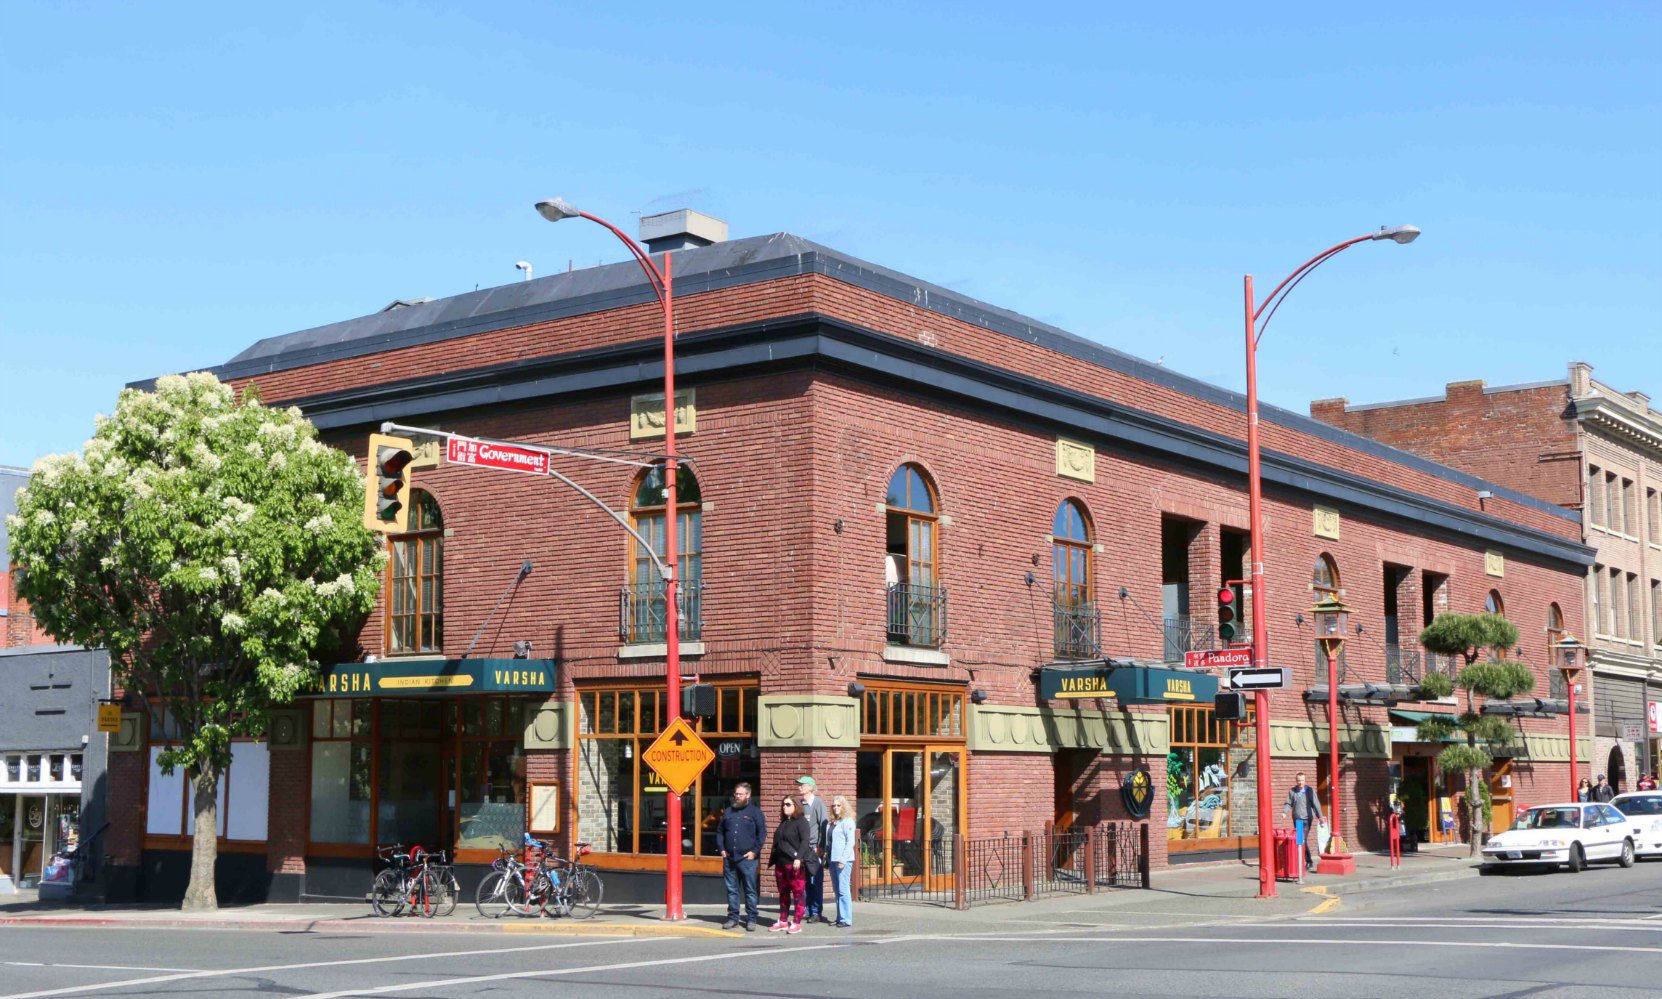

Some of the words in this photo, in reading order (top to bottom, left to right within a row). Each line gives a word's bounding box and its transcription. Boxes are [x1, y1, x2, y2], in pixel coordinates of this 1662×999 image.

[479, 445, 545, 467] Government
[1207, 652, 1250, 664] Pandora
[308, 672, 371, 692] ARSHA
[495, 670, 545, 686] VARSHA
[1061, 676, 1107, 692] VARSHA
[1166, 678, 1192, 694] VARSHA
[651, 749, 707, 762] CONSTRUCTION
[719, 742, 741, 754] OPEN
